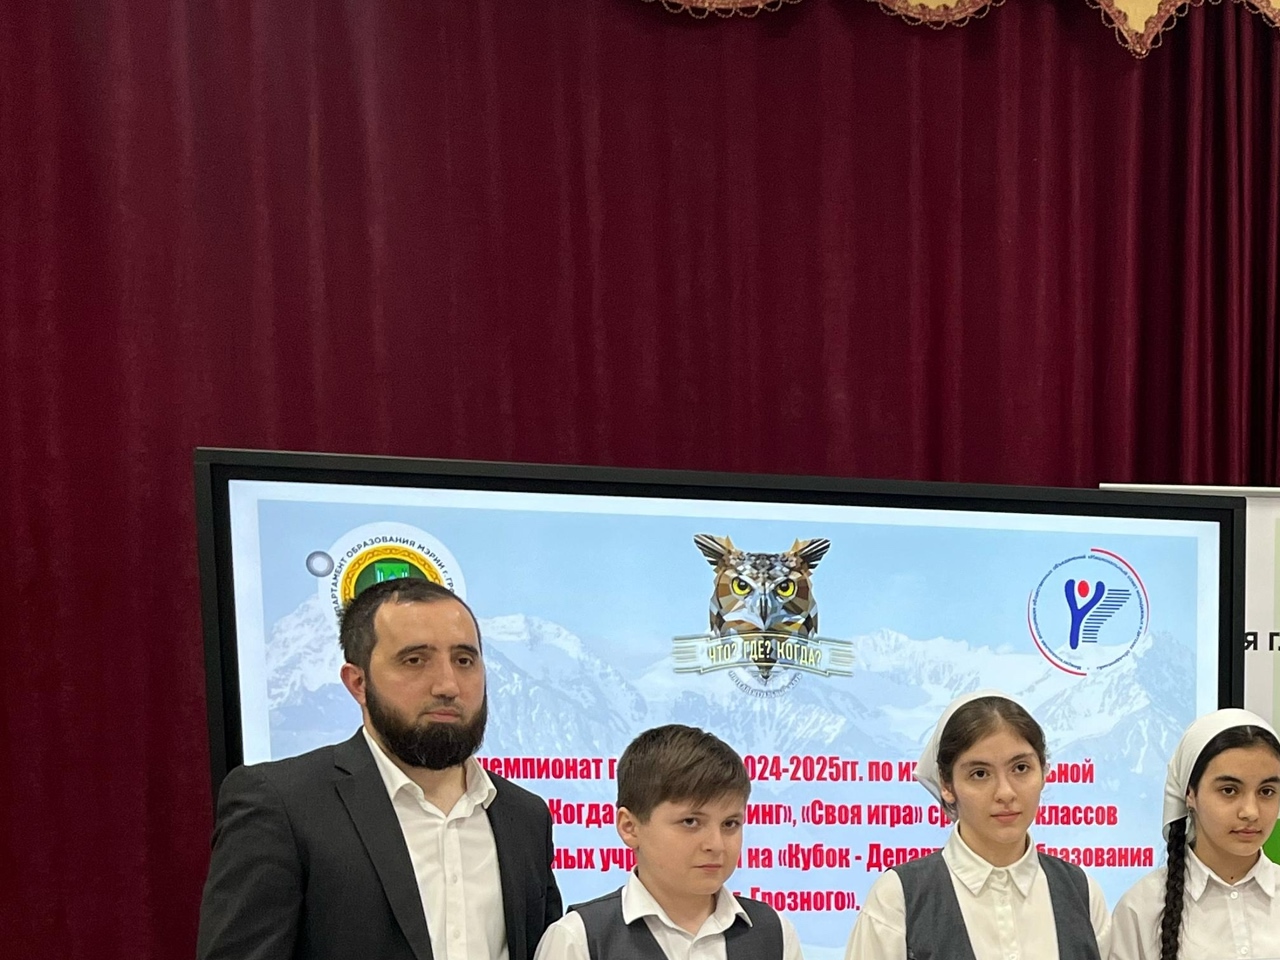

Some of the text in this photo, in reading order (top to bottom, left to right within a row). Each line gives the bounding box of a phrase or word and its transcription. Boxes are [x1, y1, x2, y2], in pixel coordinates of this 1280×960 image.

[330, 557, 348, 616] ПАРТАМЕНТ
[346, 536, 416, 558] ОБРАЗОВАНИЯ
[417, 543, 445, 570] МЭРИИ
[708, 641, 823, 667] ЧТО? ГДЕ? КОГДА?
[744, 755, 863, 782] 024-2025гг.
[868, 761, 893, 782] по
[549, 799, 614, 828] Когда
[801, 800, 862, 825] «Своя
[867, 804, 923, 828] игра»
[1035, 805, 1118, 825] классов
[747, 848, 773, 868] на
[778, 843, 850, 871] «Кубок
[1036, 843, 1154, 868] бразования
